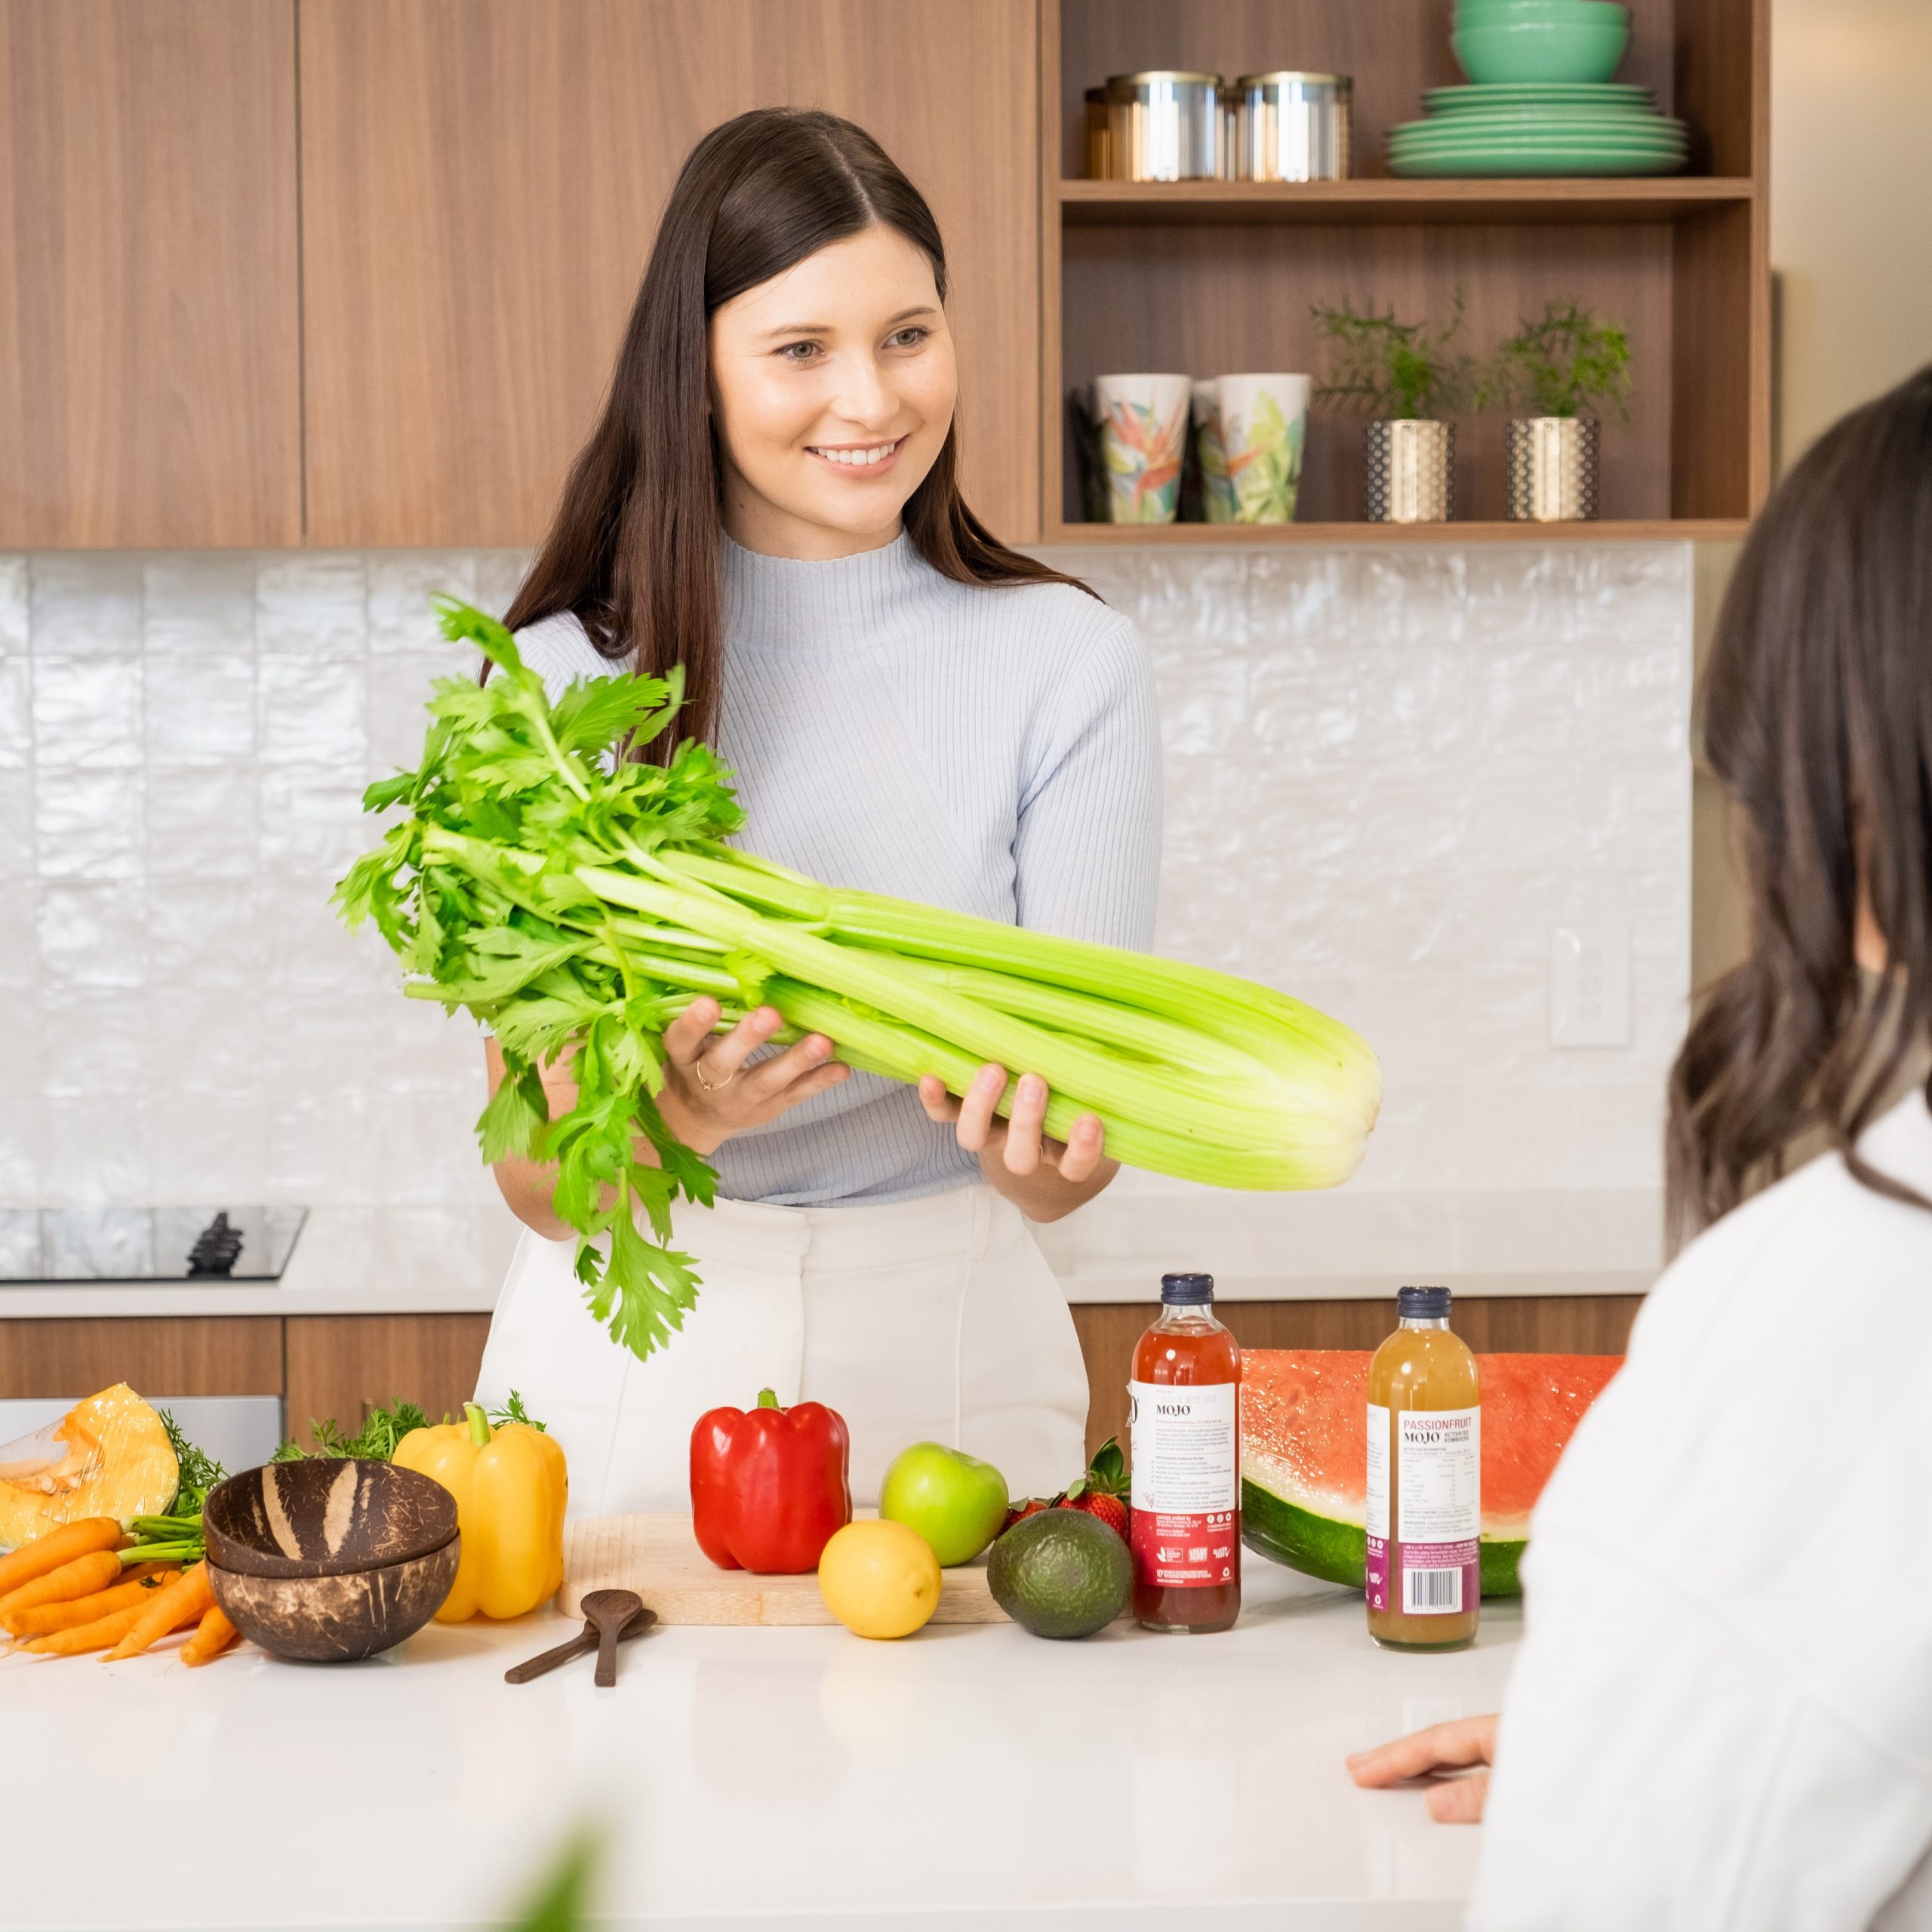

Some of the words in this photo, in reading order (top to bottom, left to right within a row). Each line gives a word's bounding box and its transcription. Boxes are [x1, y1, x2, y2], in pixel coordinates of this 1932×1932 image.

[1156, 1404, 1191, 1417] MOJO
[1404, 1417, 1472, 1431] PASSIONFRUIT
[1404, 1432, 1440, 1444] MOJO
